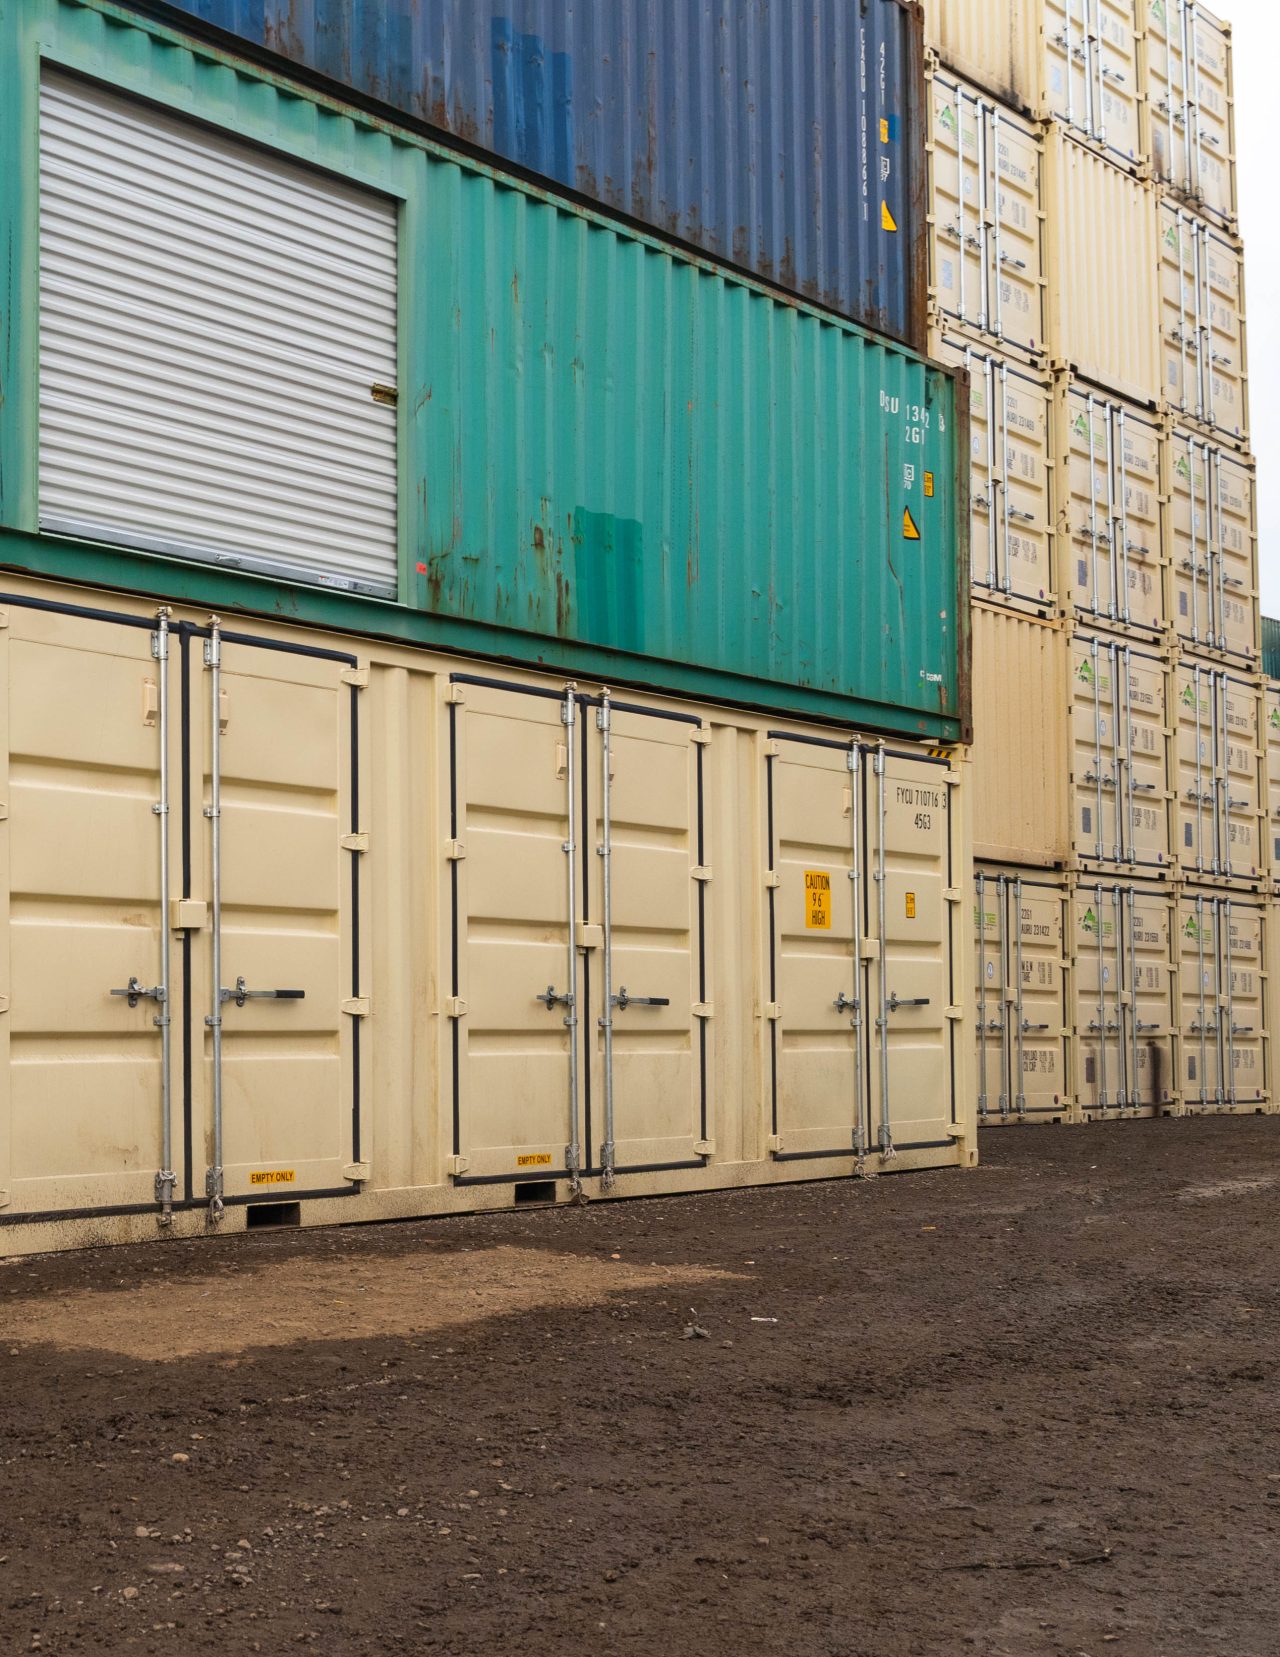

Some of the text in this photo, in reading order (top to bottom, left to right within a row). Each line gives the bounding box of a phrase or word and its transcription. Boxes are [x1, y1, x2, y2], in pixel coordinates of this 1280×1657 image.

[896, 786, 913, 805] FYCU
[915, 789, 939, 808] 710716
[914, 813, 931, 830] 45G3
[805, 874, 830, 891] CAUTION
[812, 910, 826, 926] HIGH
[518, 1154, 551, 1166] EMPTY ONLY
[251, 1171, 294, 1184] EMPTY ONLY
